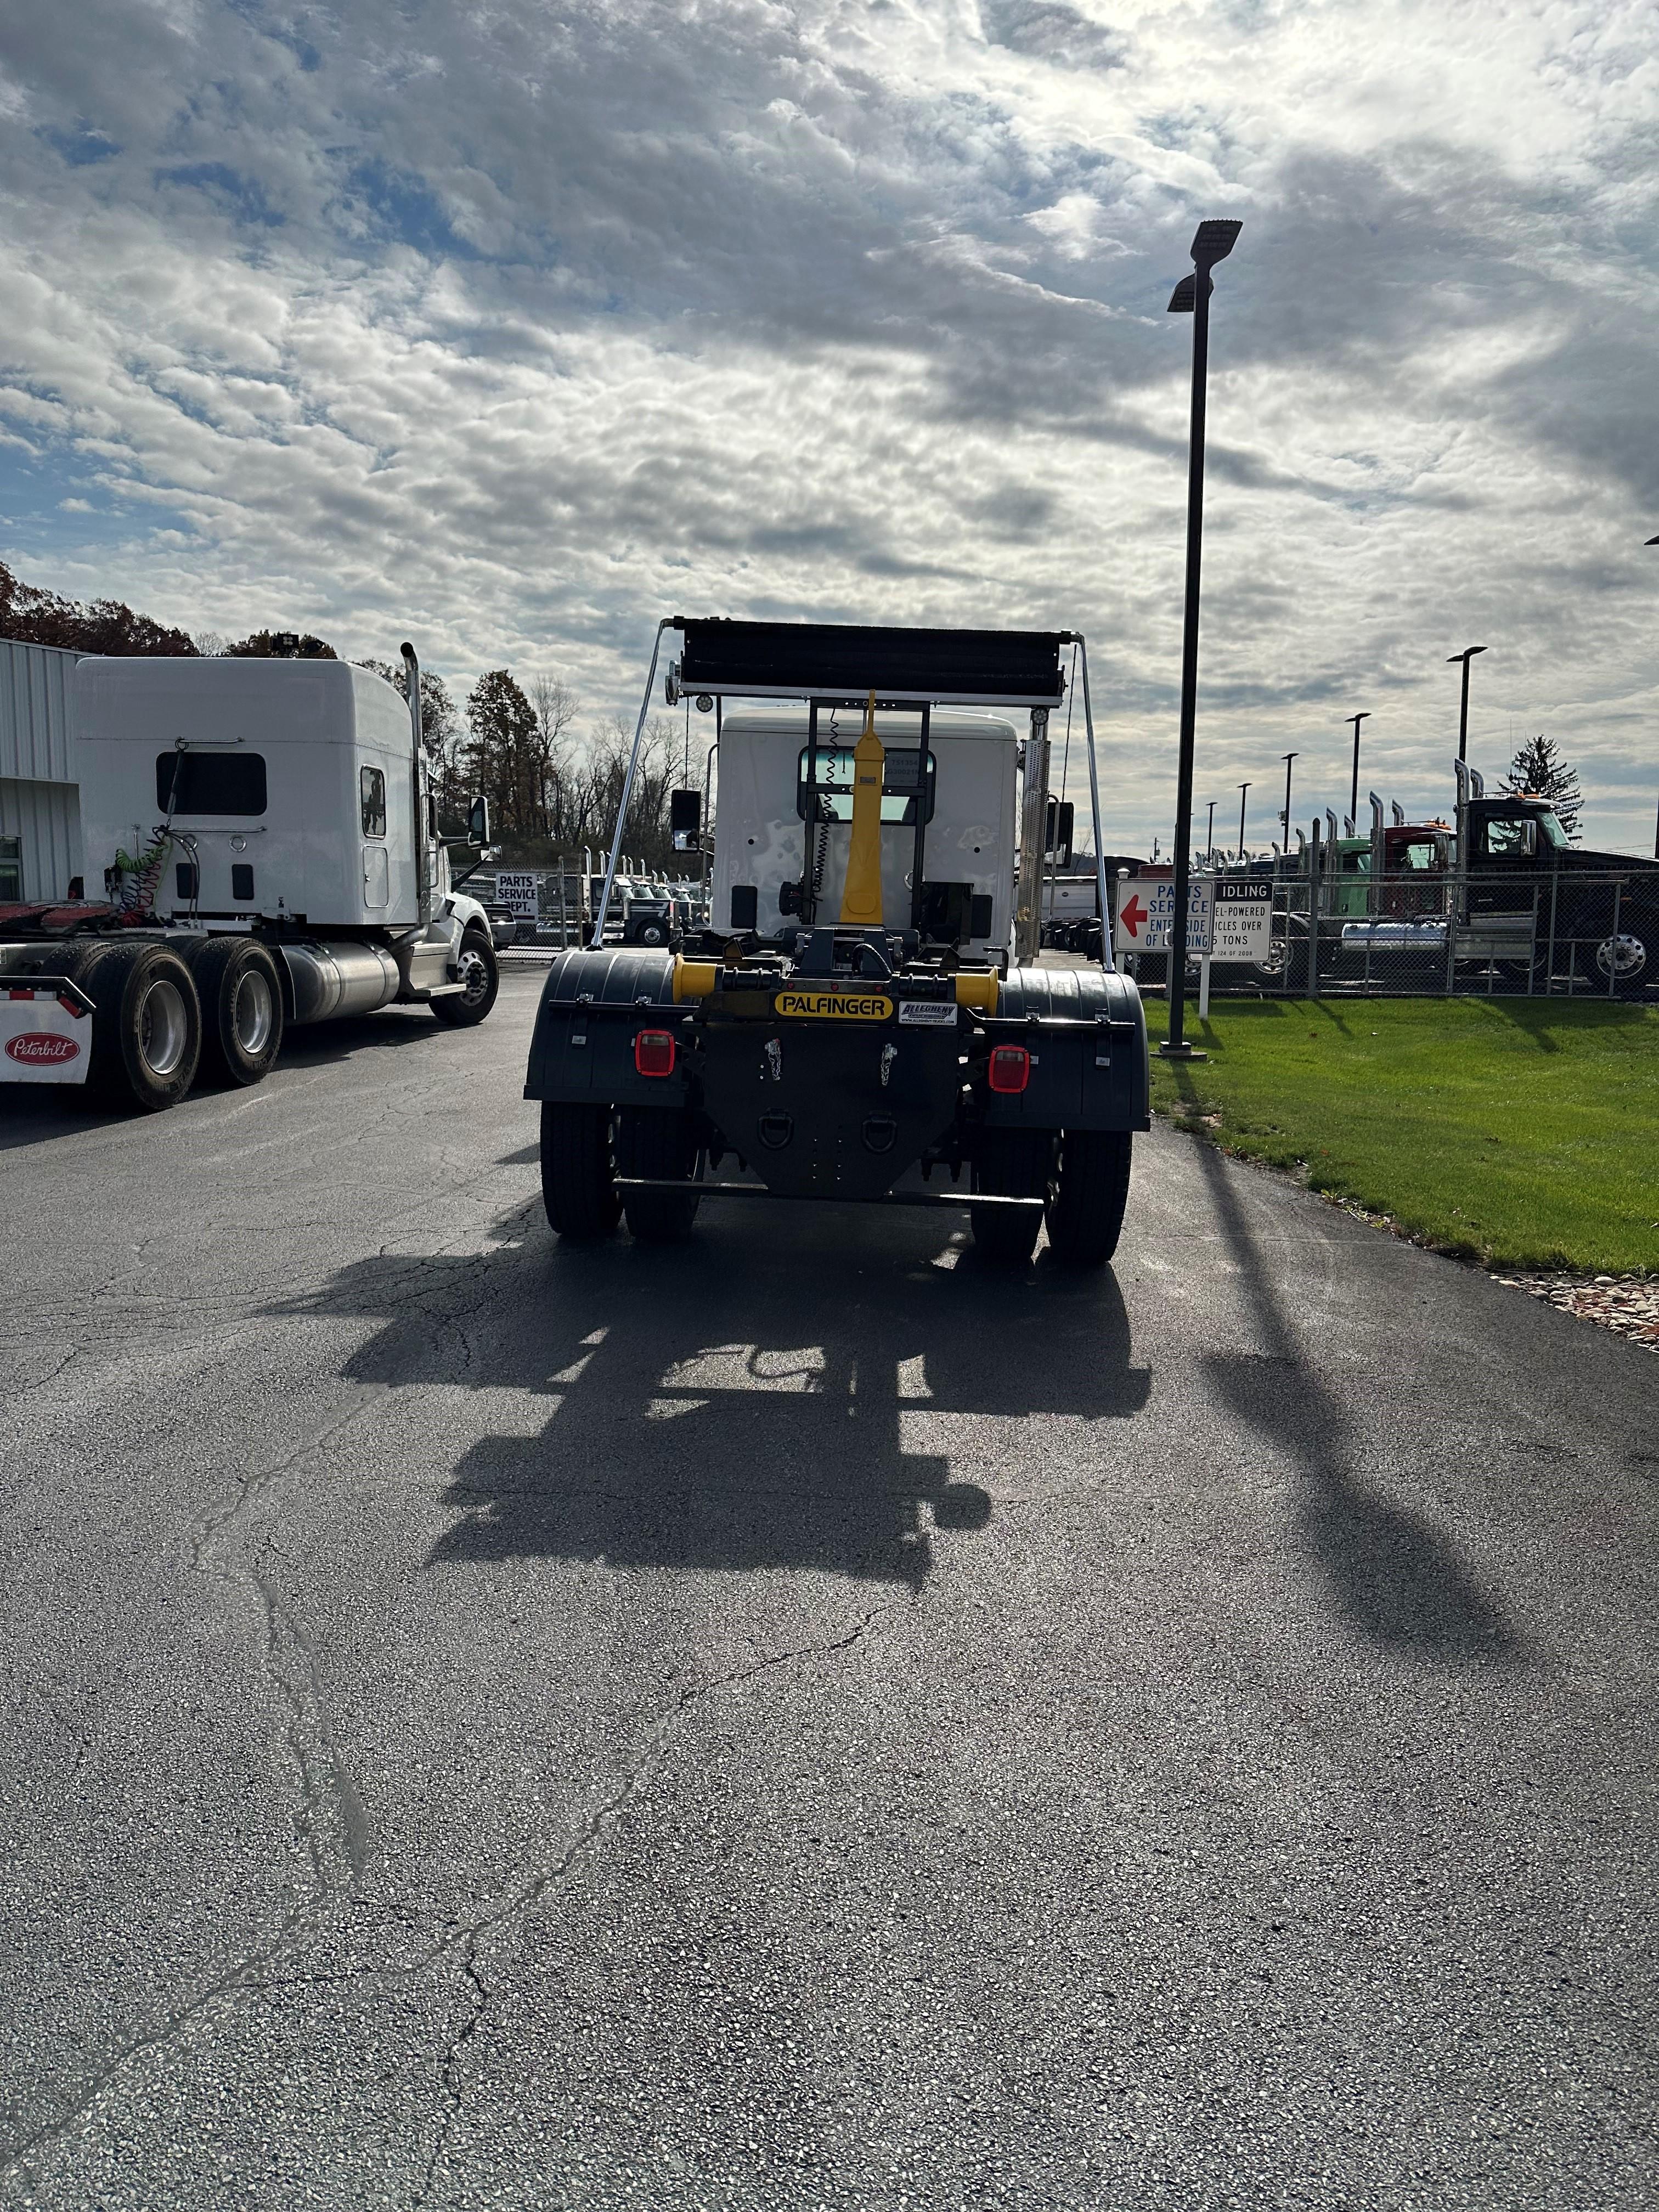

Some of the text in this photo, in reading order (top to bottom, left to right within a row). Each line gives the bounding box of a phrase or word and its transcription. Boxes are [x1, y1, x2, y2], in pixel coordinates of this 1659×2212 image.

[500, 876, 533, 887] PARTS
[498, 888, 536, 900] SERVICE
[1158, 885, 1201, 898] PATS
[1223, 885, 1267, 897] IDLING
[1149, 900, 1209, 913] SERCE
[1150, 919, 1174, 932] ENTE
[1242, 921, 1261, 930] OVER
[1146, 934, 1158, 946] OF
[1223, 935, 1248, 945] TONS
[783, 996, 885, 1015] PALFINGER
[901, 1003, 955, 1016] ALLEGHENY
[14, 1039, 73, 1056] Peterbilt
